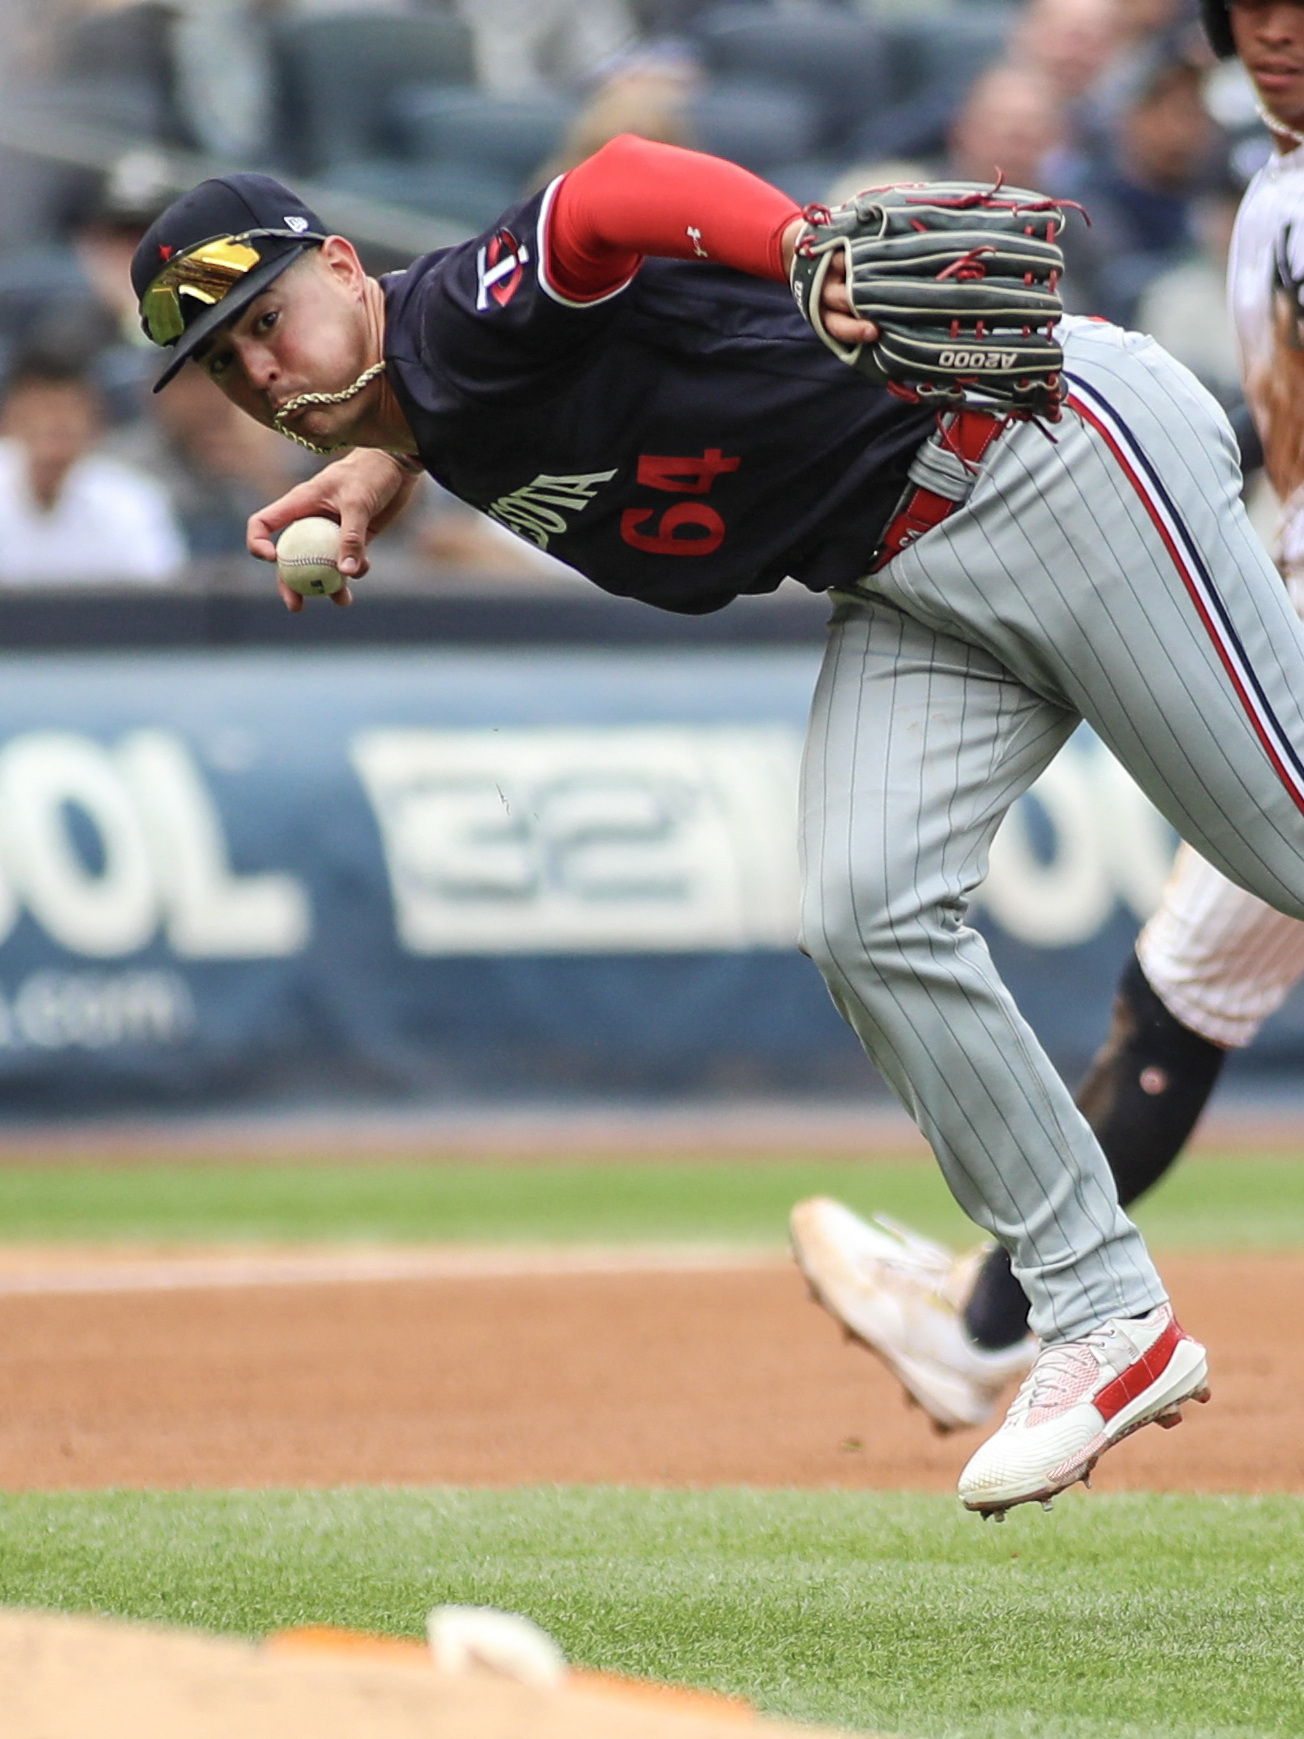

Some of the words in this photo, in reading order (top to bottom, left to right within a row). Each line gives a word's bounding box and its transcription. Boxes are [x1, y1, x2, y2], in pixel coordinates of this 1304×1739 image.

[938, 350, 1018, 370] A2000
[619, 448, 742, 556] 64
[0, 727, 312, 960] OL
